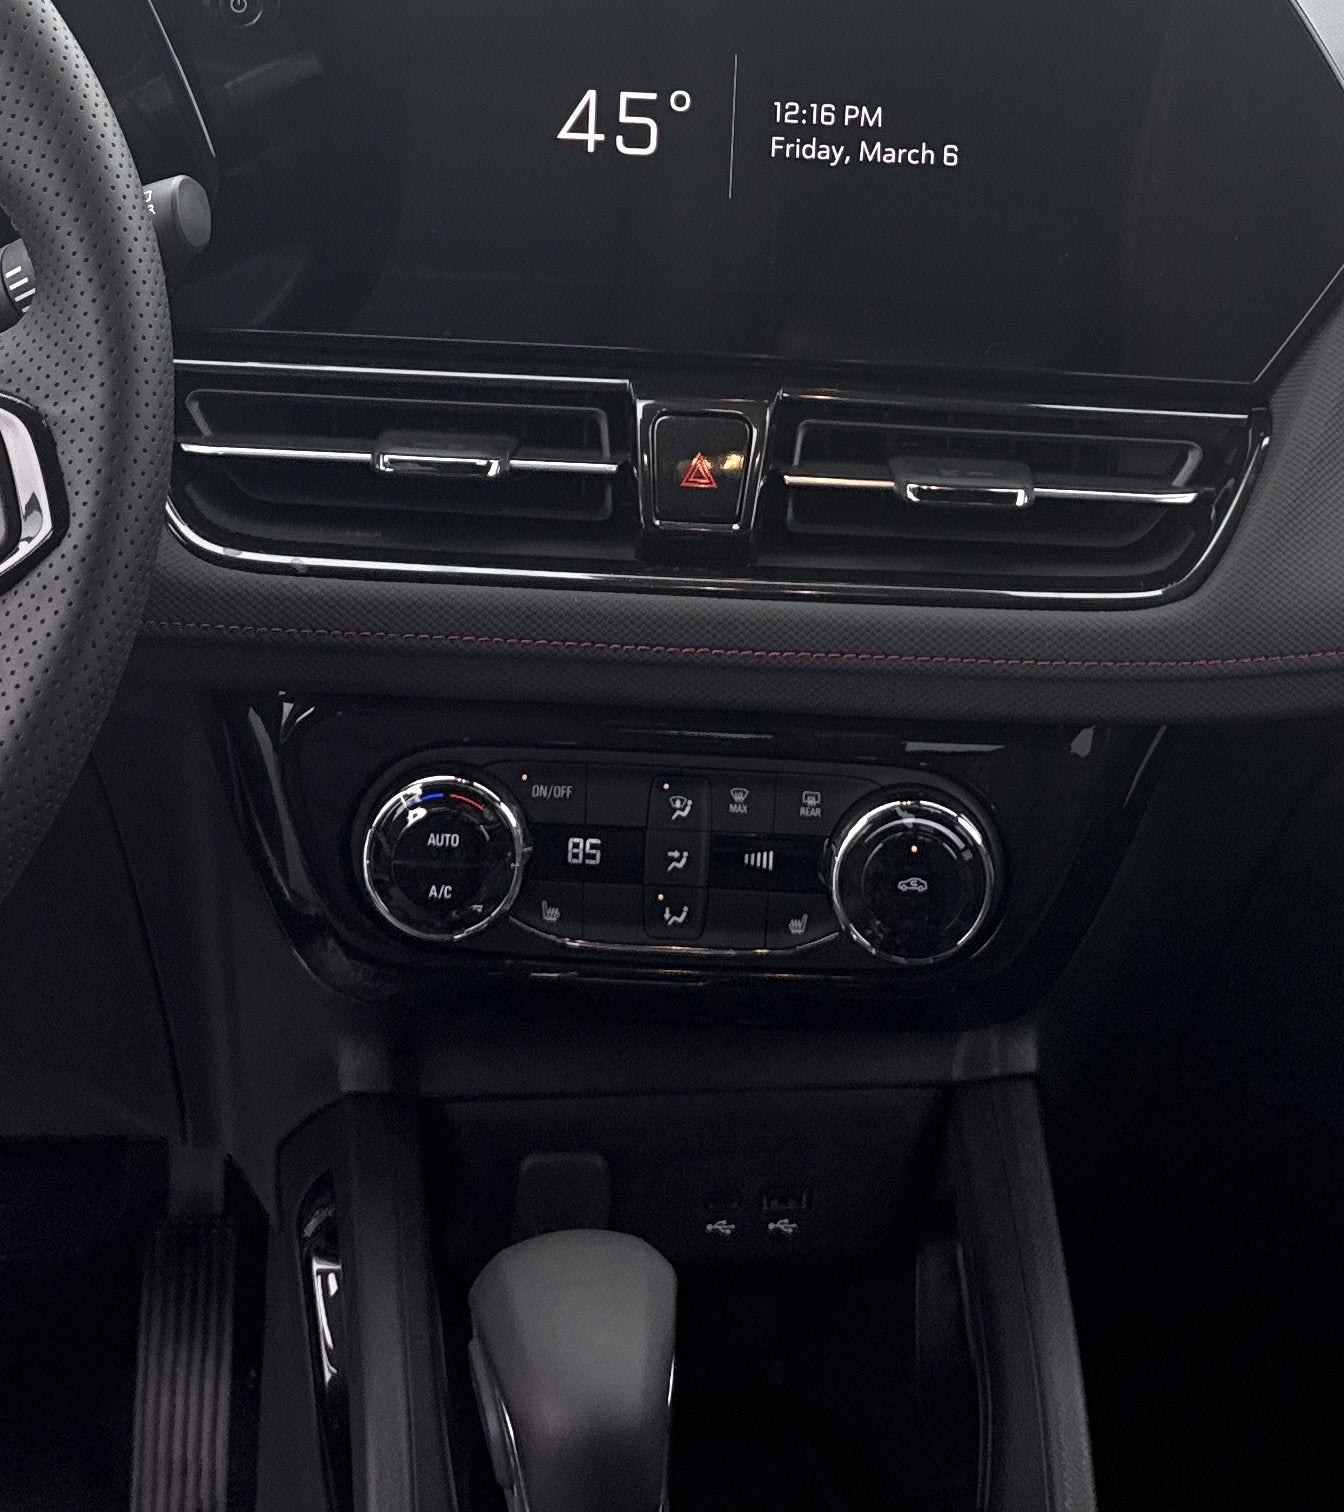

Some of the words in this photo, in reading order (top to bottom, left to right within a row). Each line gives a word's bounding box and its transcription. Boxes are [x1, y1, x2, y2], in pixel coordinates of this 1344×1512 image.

[773, 100, 836, 127] 12:16
[844, 105, 883, 128] PM
[771, 136, 852, 166] Friday,
[859, 140, 935, 166] March
[943, 144, 959, 167] 6
[531, 784, 574, 800] ON/OFF
[729, 803, 748, 814] MAX
[799, 806, 822, 818] REAR
[427, 832, 460, 848] AUTO
[567, 836, 602, 866] 85
[428, 884, 453, 900] A/C
